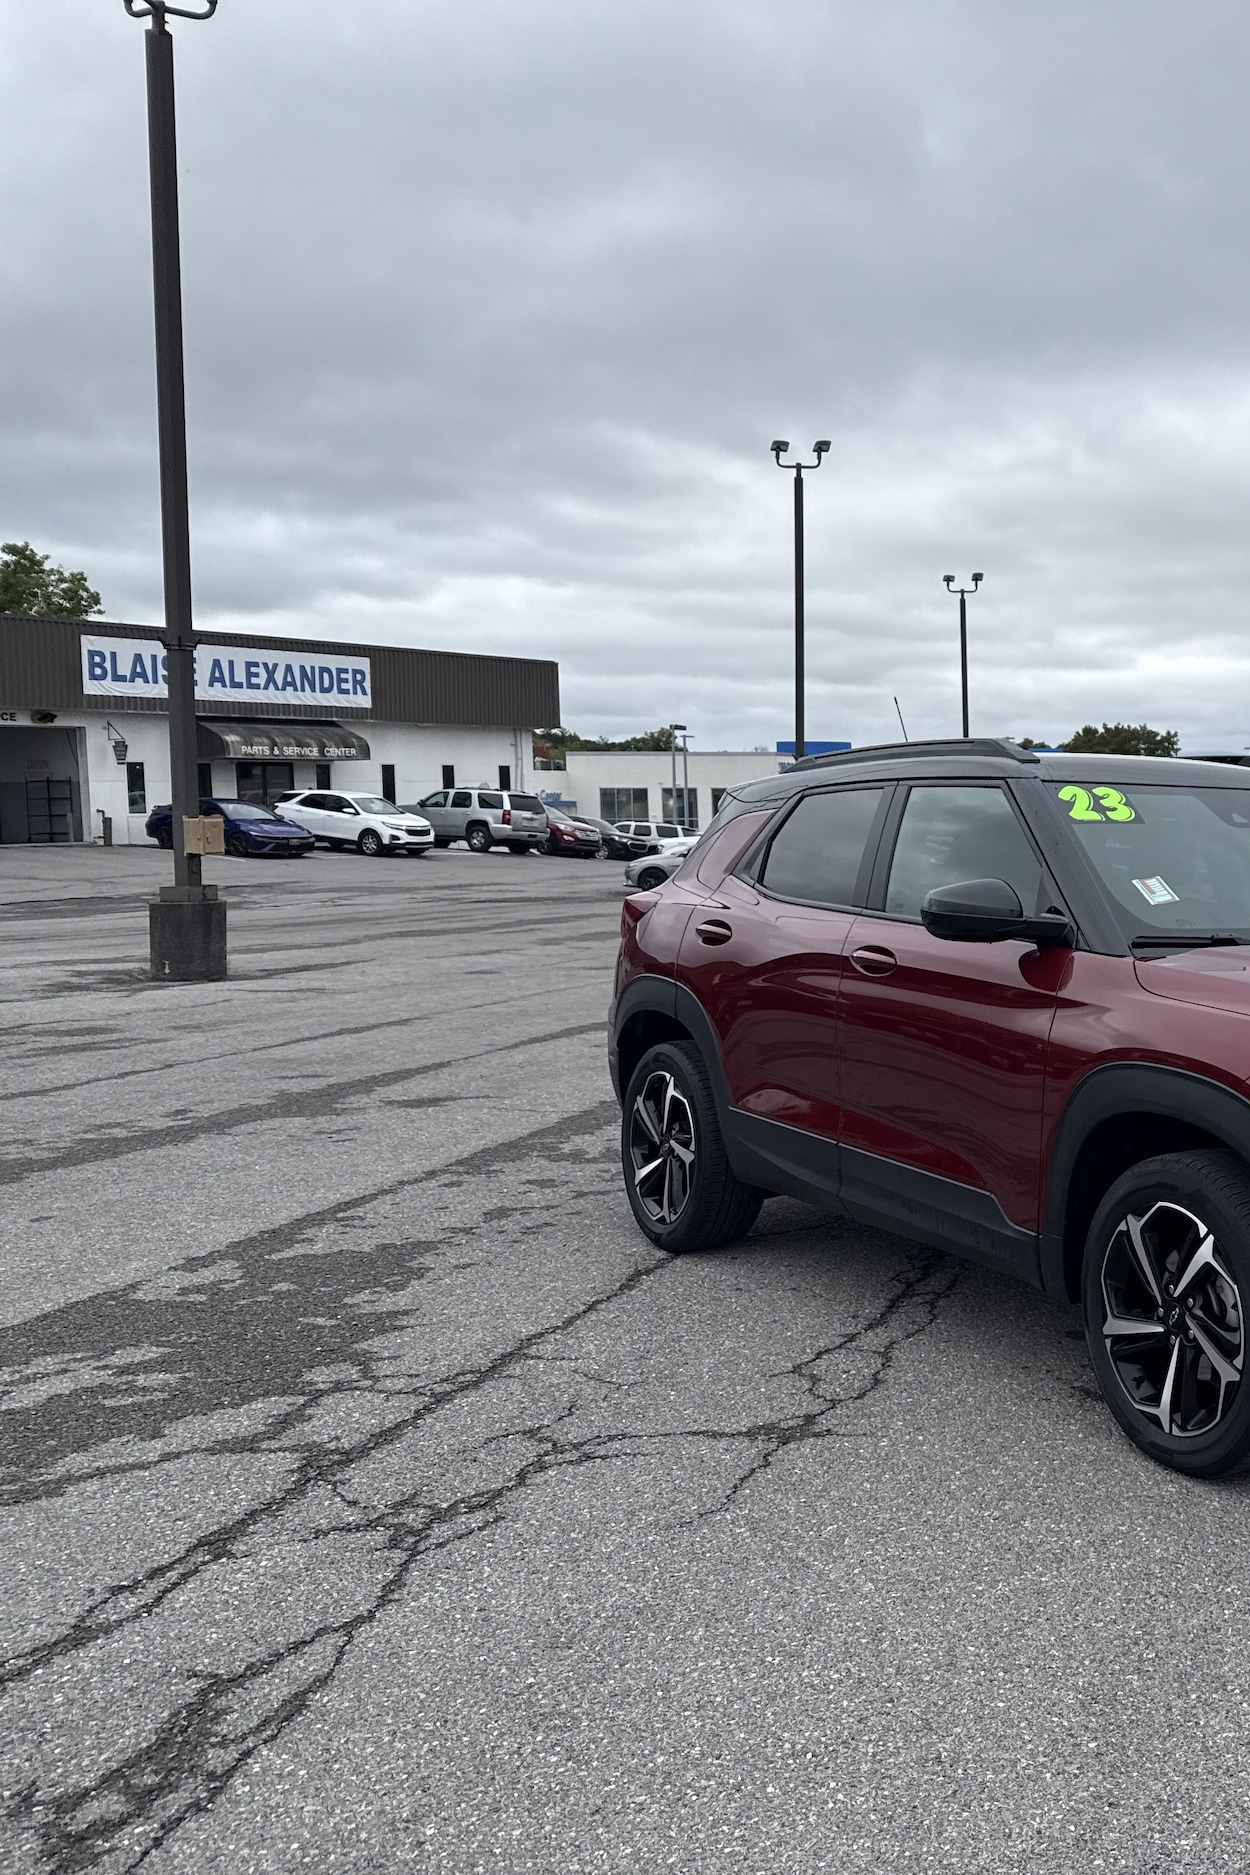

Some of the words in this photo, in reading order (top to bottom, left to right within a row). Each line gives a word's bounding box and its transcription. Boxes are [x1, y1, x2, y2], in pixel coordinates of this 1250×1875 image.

[87, 649, 198, 687] BLAI
[208, 658, 368, 696] ALEXANDER
[241, 745, 270, 755] PARTS
[273, 745, 280, 755] &
[282, 746, 319, 756] SERVICE
[324, 747, 357, 756] CENTER
[1057, 785, 1136, 822] 23
